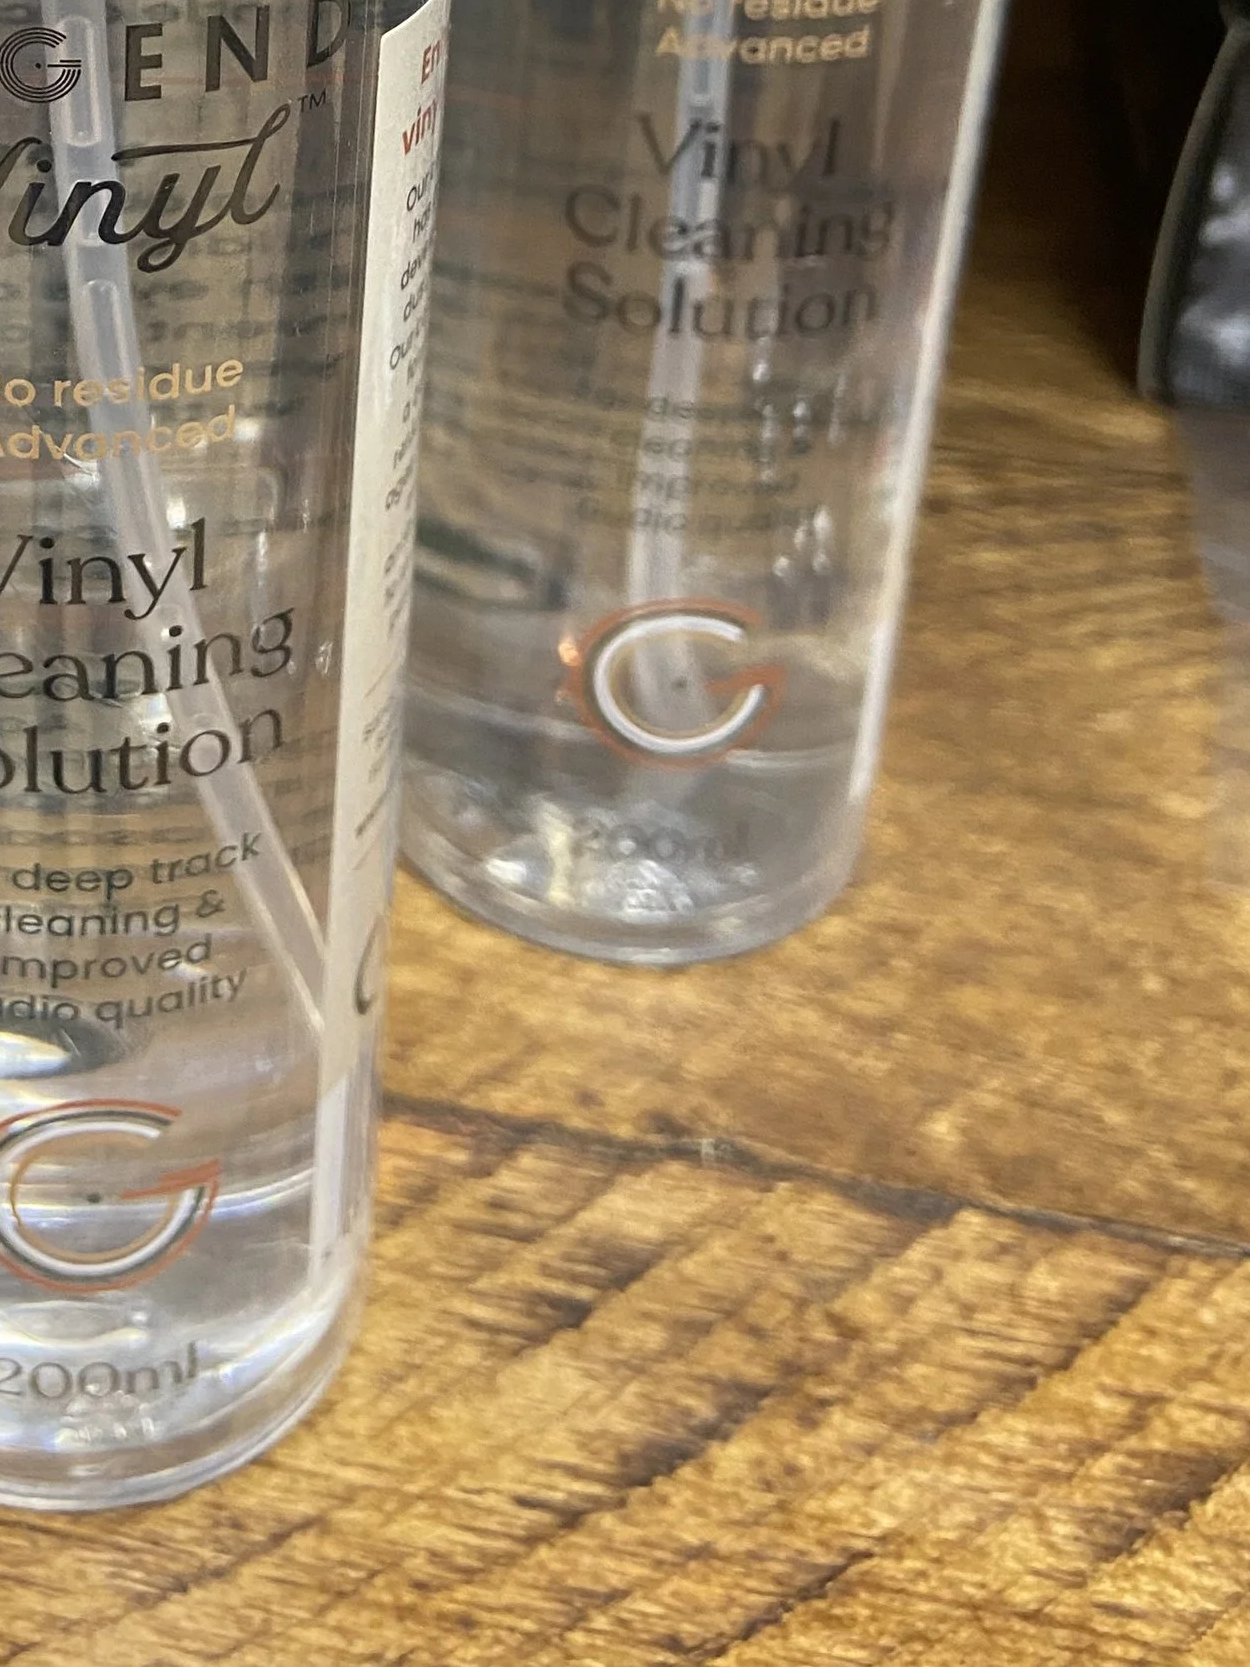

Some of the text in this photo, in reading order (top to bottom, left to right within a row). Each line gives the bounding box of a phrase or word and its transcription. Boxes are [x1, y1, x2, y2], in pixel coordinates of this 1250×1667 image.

[655, 24, 871, 65] Advanced
[638, 114, 842, 188] Vinyl
[563, 184, 897, 263] Cleaning
[561, 260, 880, 337] Solution
[53, 358, 245, 408] residue
[12, 860, 135, 901] deep
[151, 832, 262, 886] track
[196, 889, 226, 917] &
[94, 964, 249, 1030] quality
